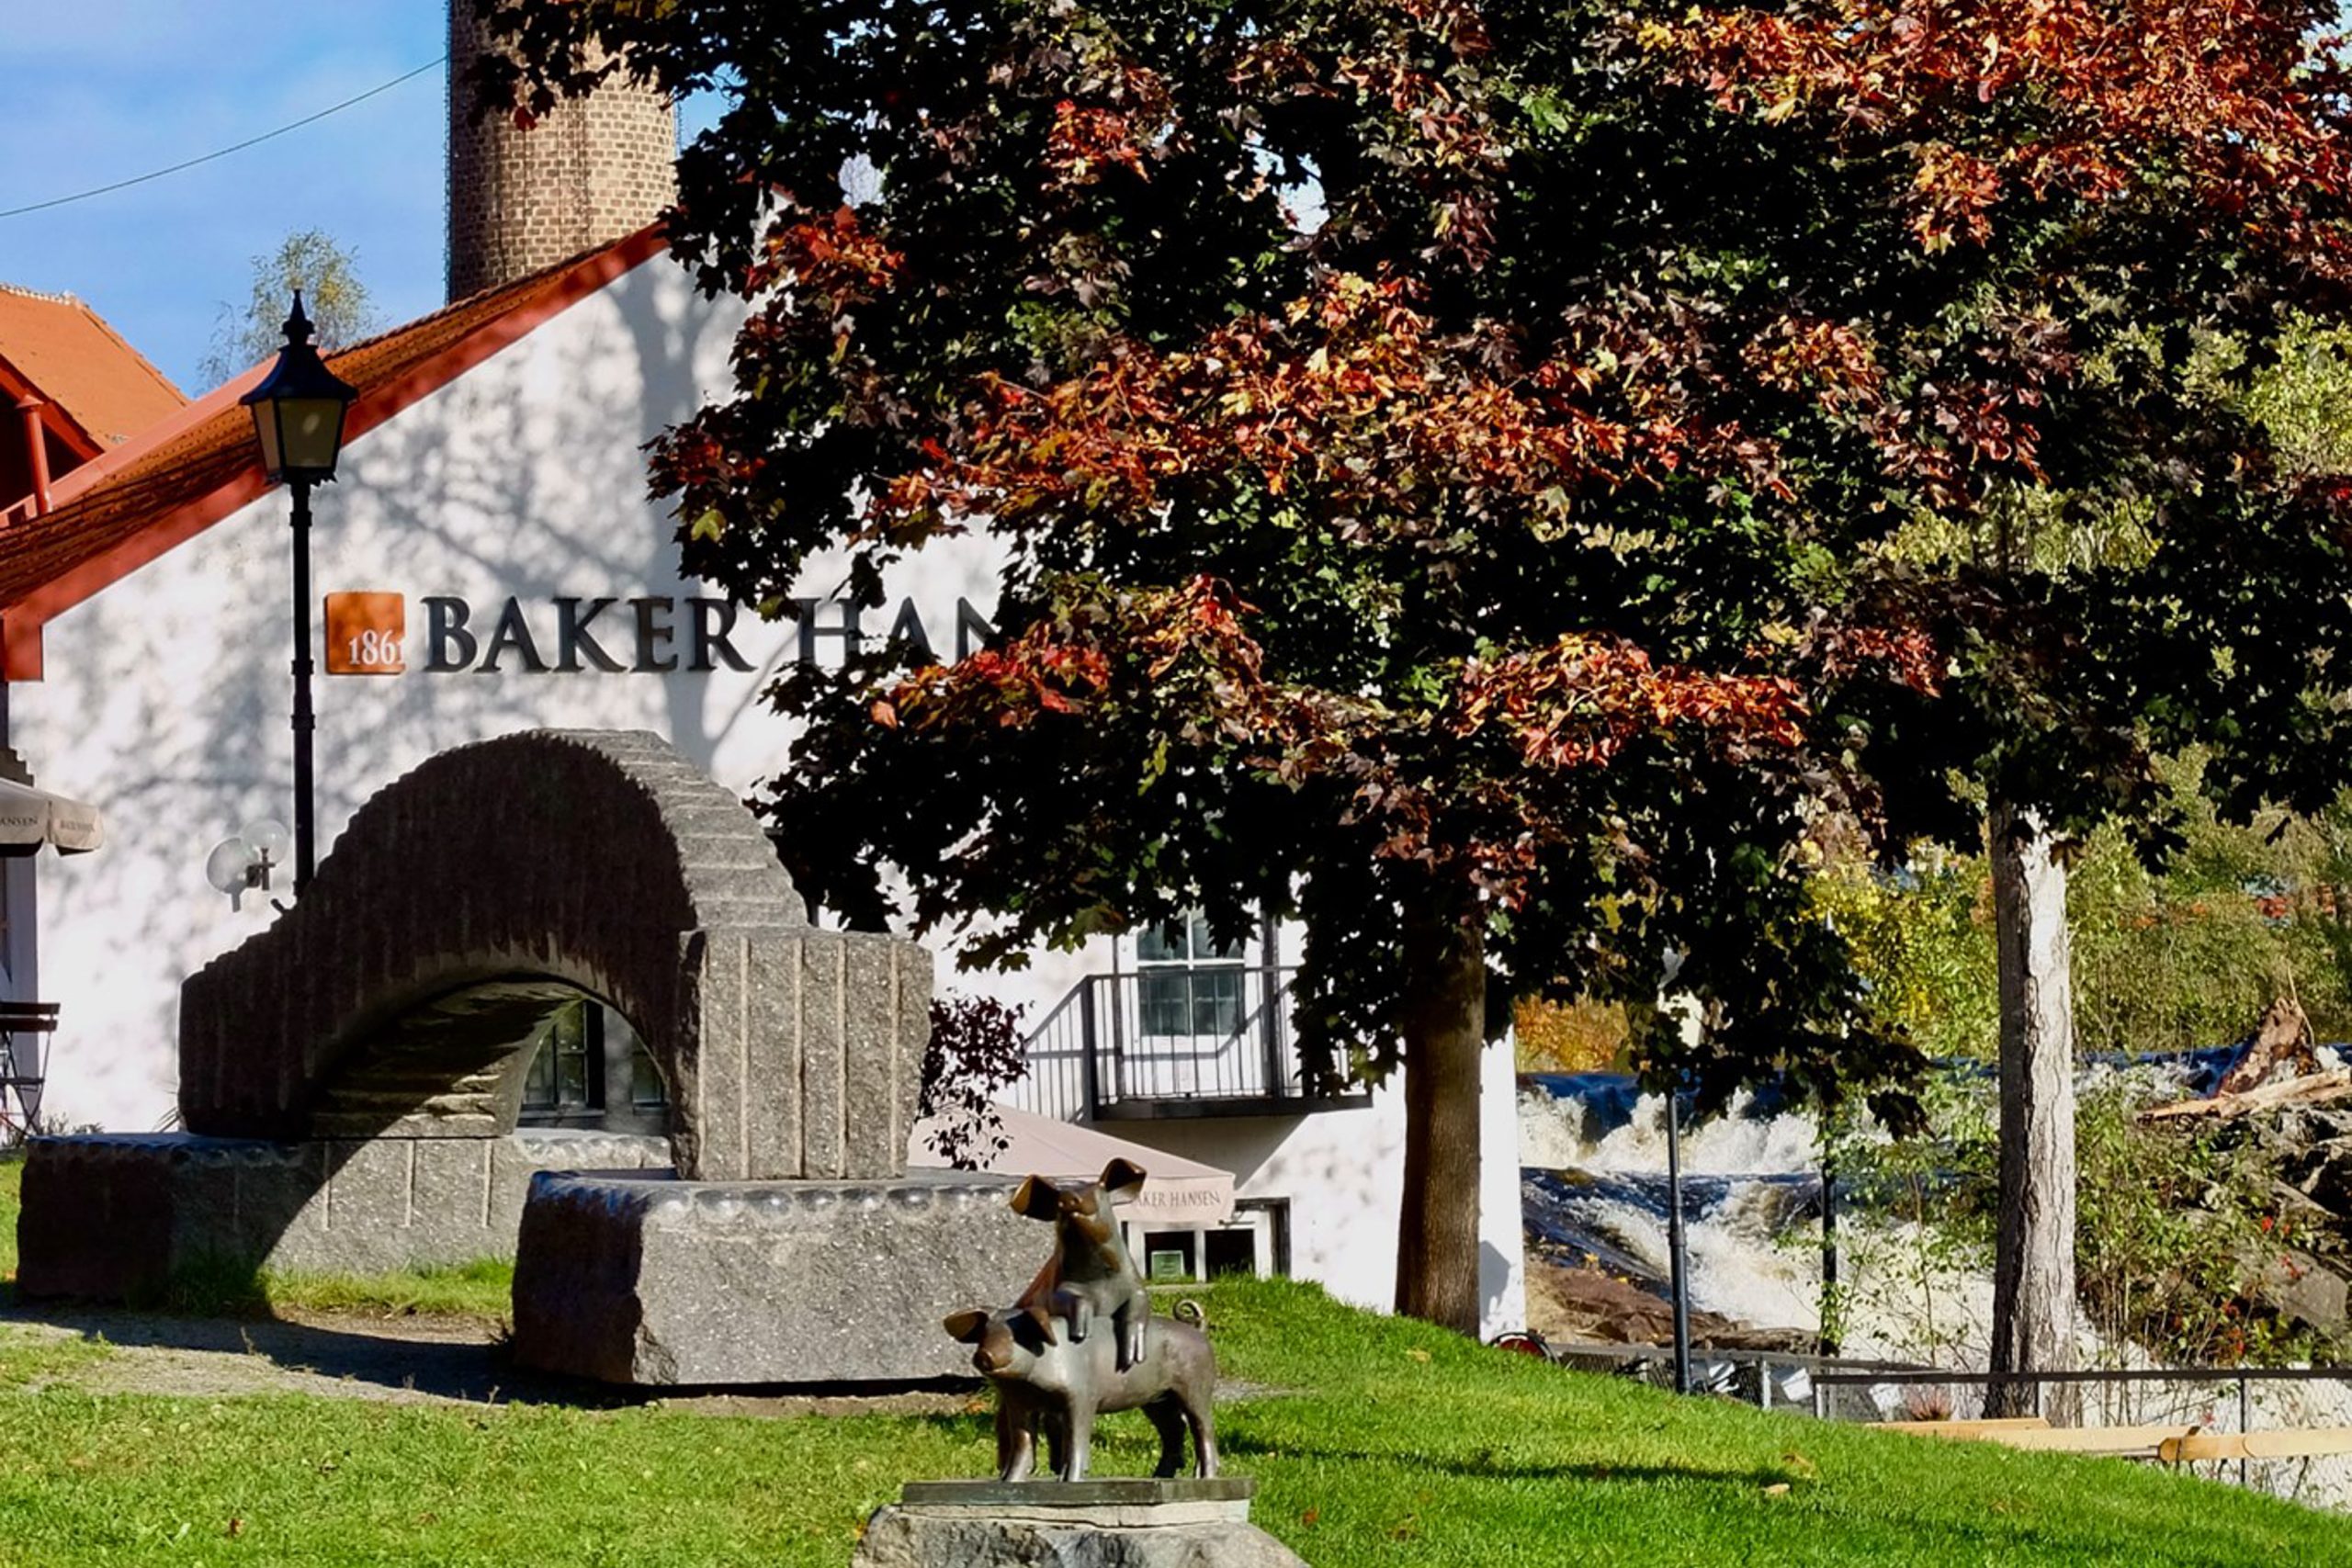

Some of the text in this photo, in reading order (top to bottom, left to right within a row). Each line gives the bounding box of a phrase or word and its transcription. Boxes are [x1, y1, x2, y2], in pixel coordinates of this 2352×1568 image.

[349, 630, 404, 665] 1861
[422, 595, 757, 674] BAKER
[1170, 1190, 1221, 1207] HANSEN
